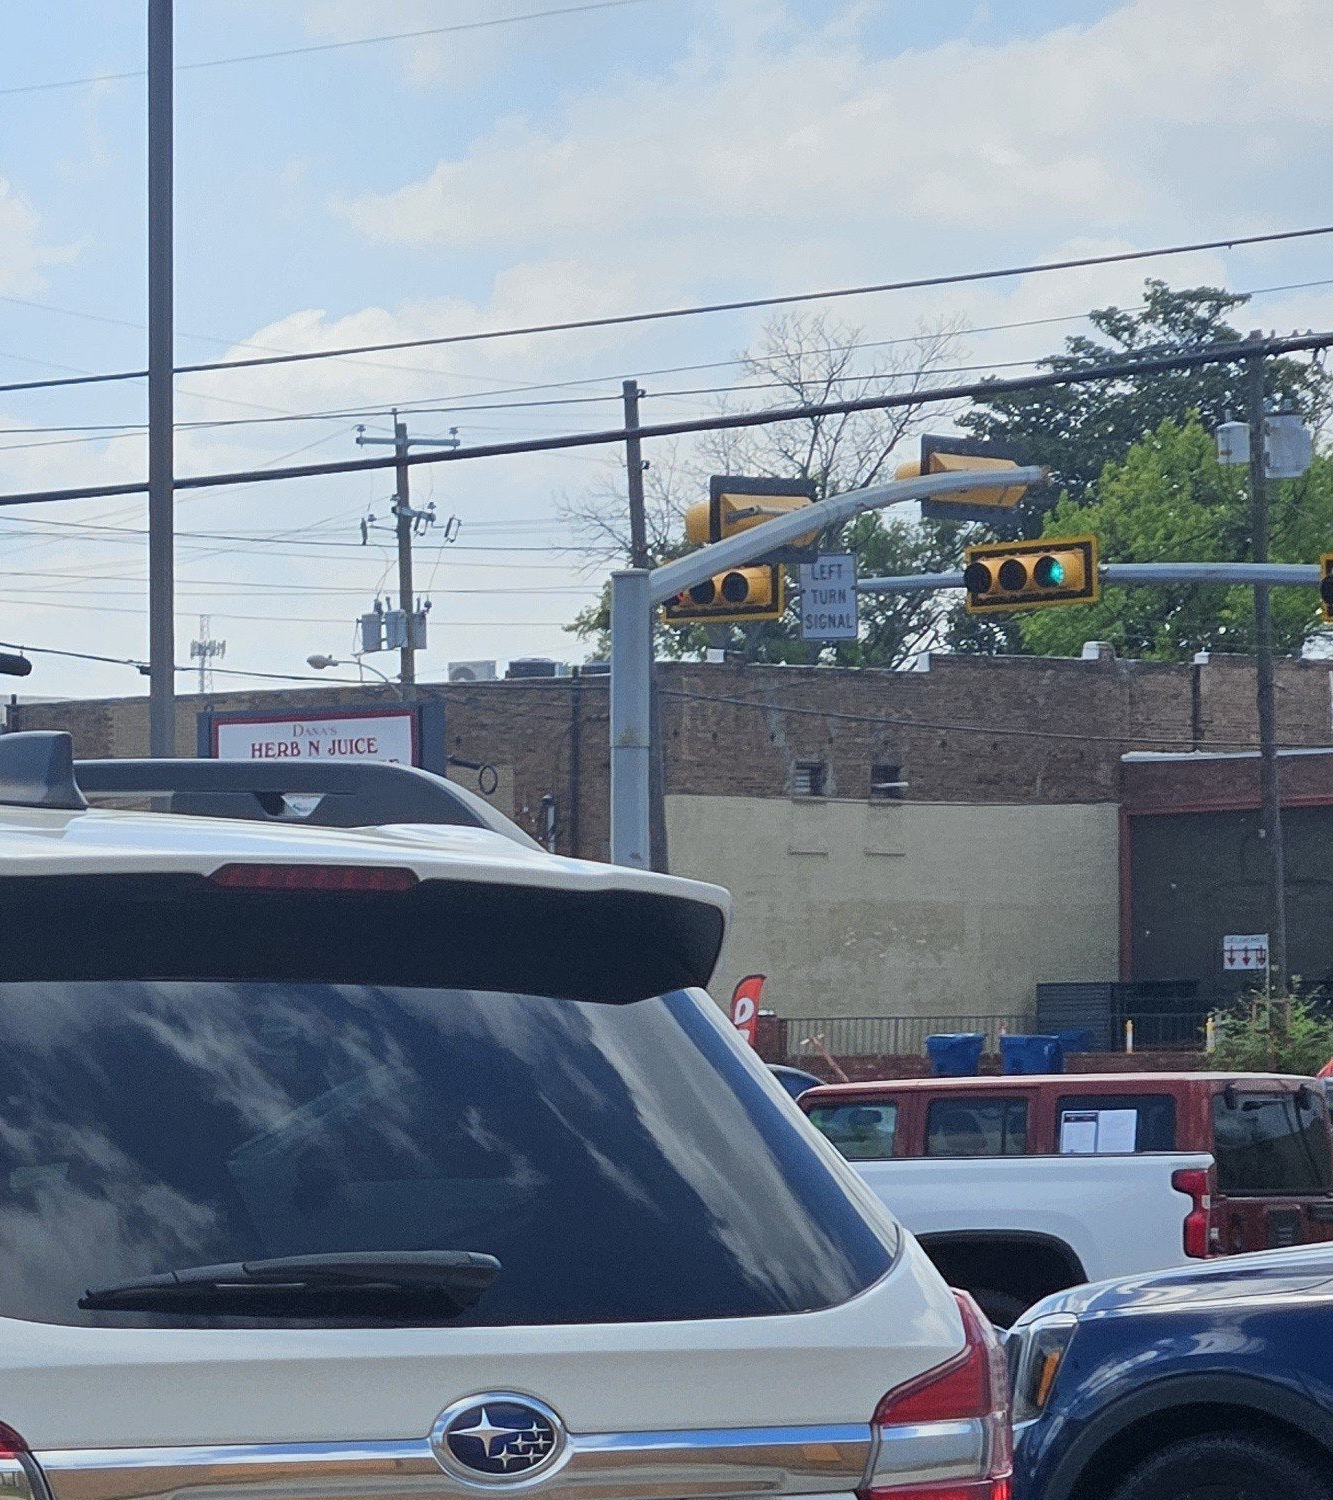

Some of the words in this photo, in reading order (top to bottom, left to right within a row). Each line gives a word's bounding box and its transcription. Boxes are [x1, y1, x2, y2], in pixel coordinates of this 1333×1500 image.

[812, 563, 843, 581] LEFT
[810, 588, 847, 605] TURN
[805, 613, 854, 630] SIGNAL
[250, 740, 301, 759] HERB
[308, 740, 321, 757] N
[327, 737, 379, 756] JUICE
